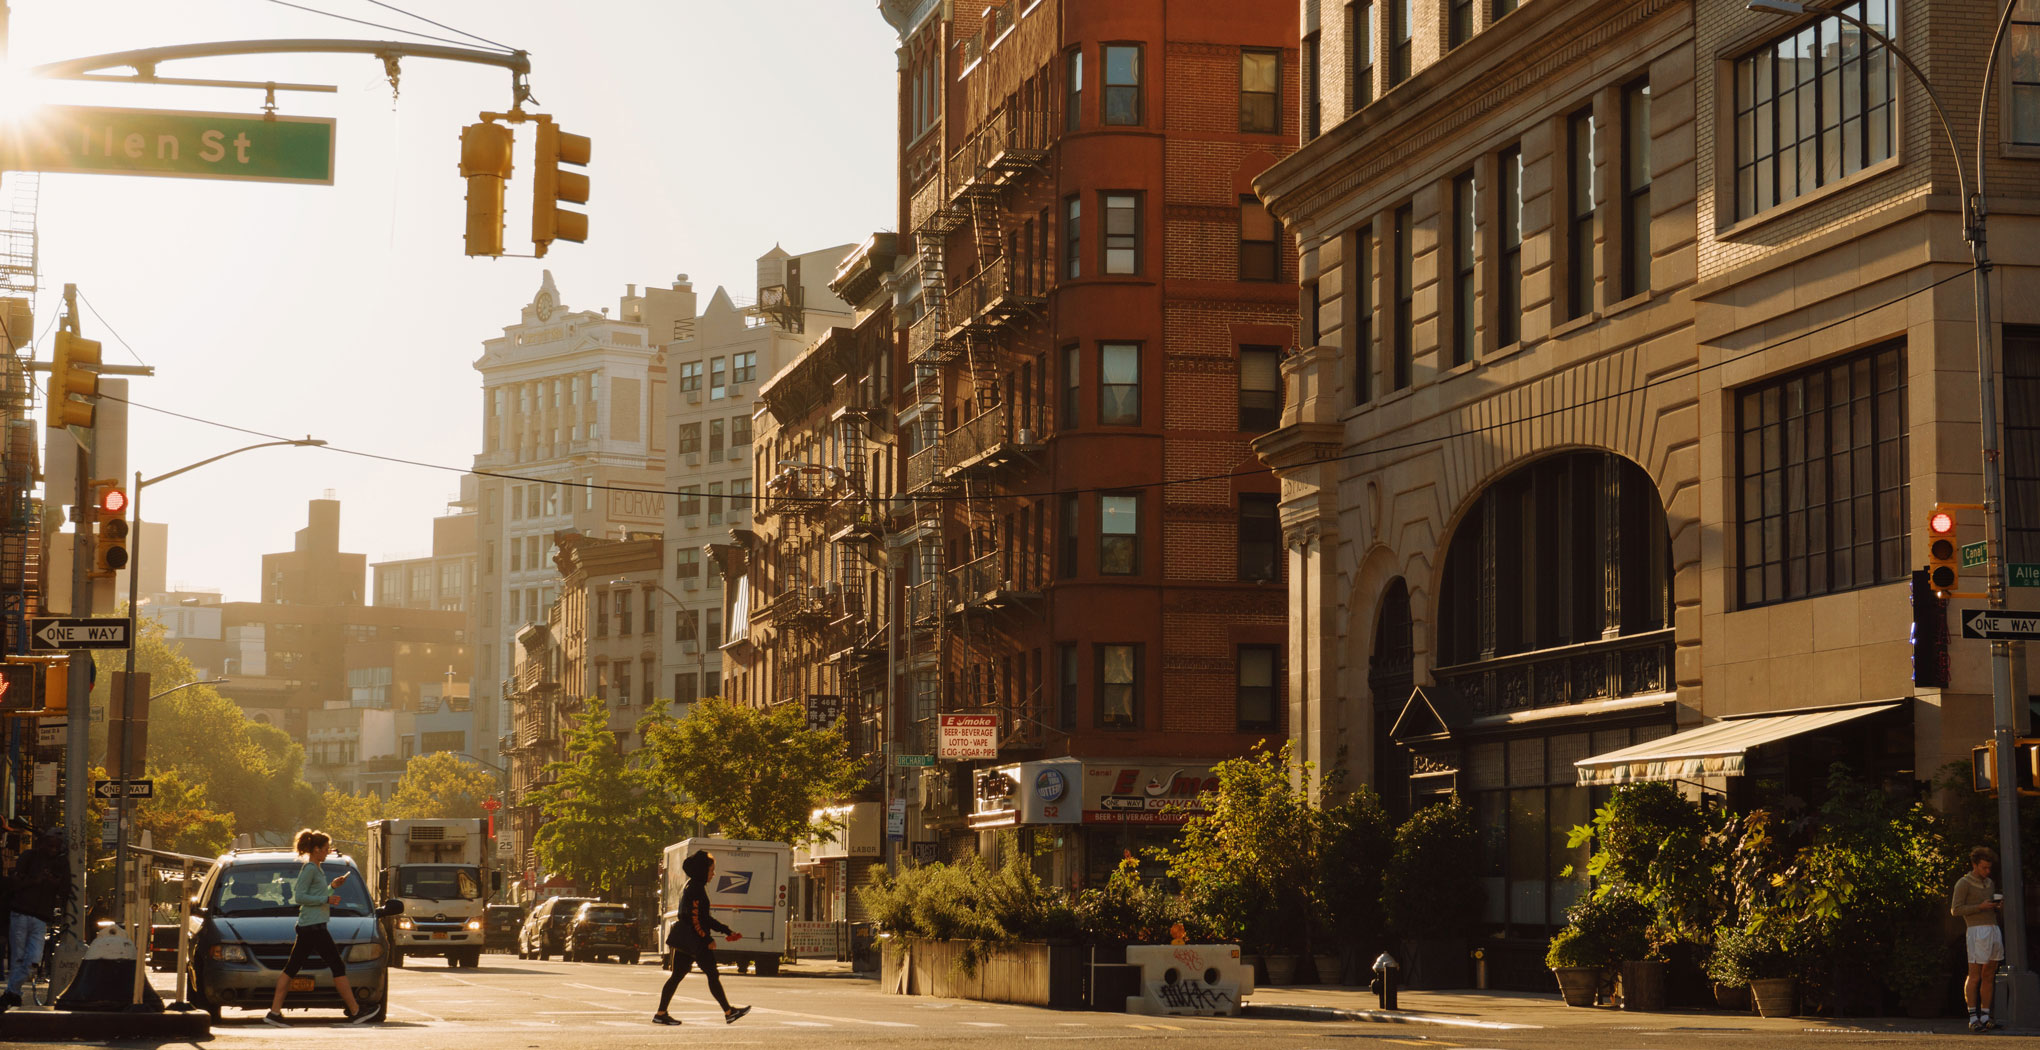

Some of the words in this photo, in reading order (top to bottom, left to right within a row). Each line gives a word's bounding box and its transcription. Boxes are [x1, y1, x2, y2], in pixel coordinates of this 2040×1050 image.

[52, 124, 180, 160] llen
[199, 129, 251, 164] St
[614, 490, 664, 516] FORWA
[1965, 545, 1983, 559] Canal
[2016, 567, 2040, 578] Alle
[1975, 619, 2000, 631] ONE
[2011, 619, 2036, 631] WAY
[47, 628, 74, 640] ONE
[88, 628, 118, 640] WAY
[947, 717, 955, 726] E
[944, 728, 959, 737] BEER
[961, 728, 993, 737] BEVERAGE
[949, 738, 969, 747] LOTTO
[973, 738, 988, 747] VAPE
[946, 748, 957, 756] CIG
[962, 748, 979, 757] CIGAR
[983, 748, 996, 757] PIPE
[897, 756, 926, 766] ORCHARD
[1112, 769, 1140, 795] E
[1044, 806, 1058, 818] 52
[1095, 813, 1111, 821] BEER
[499, 842, 513, 850] 25
